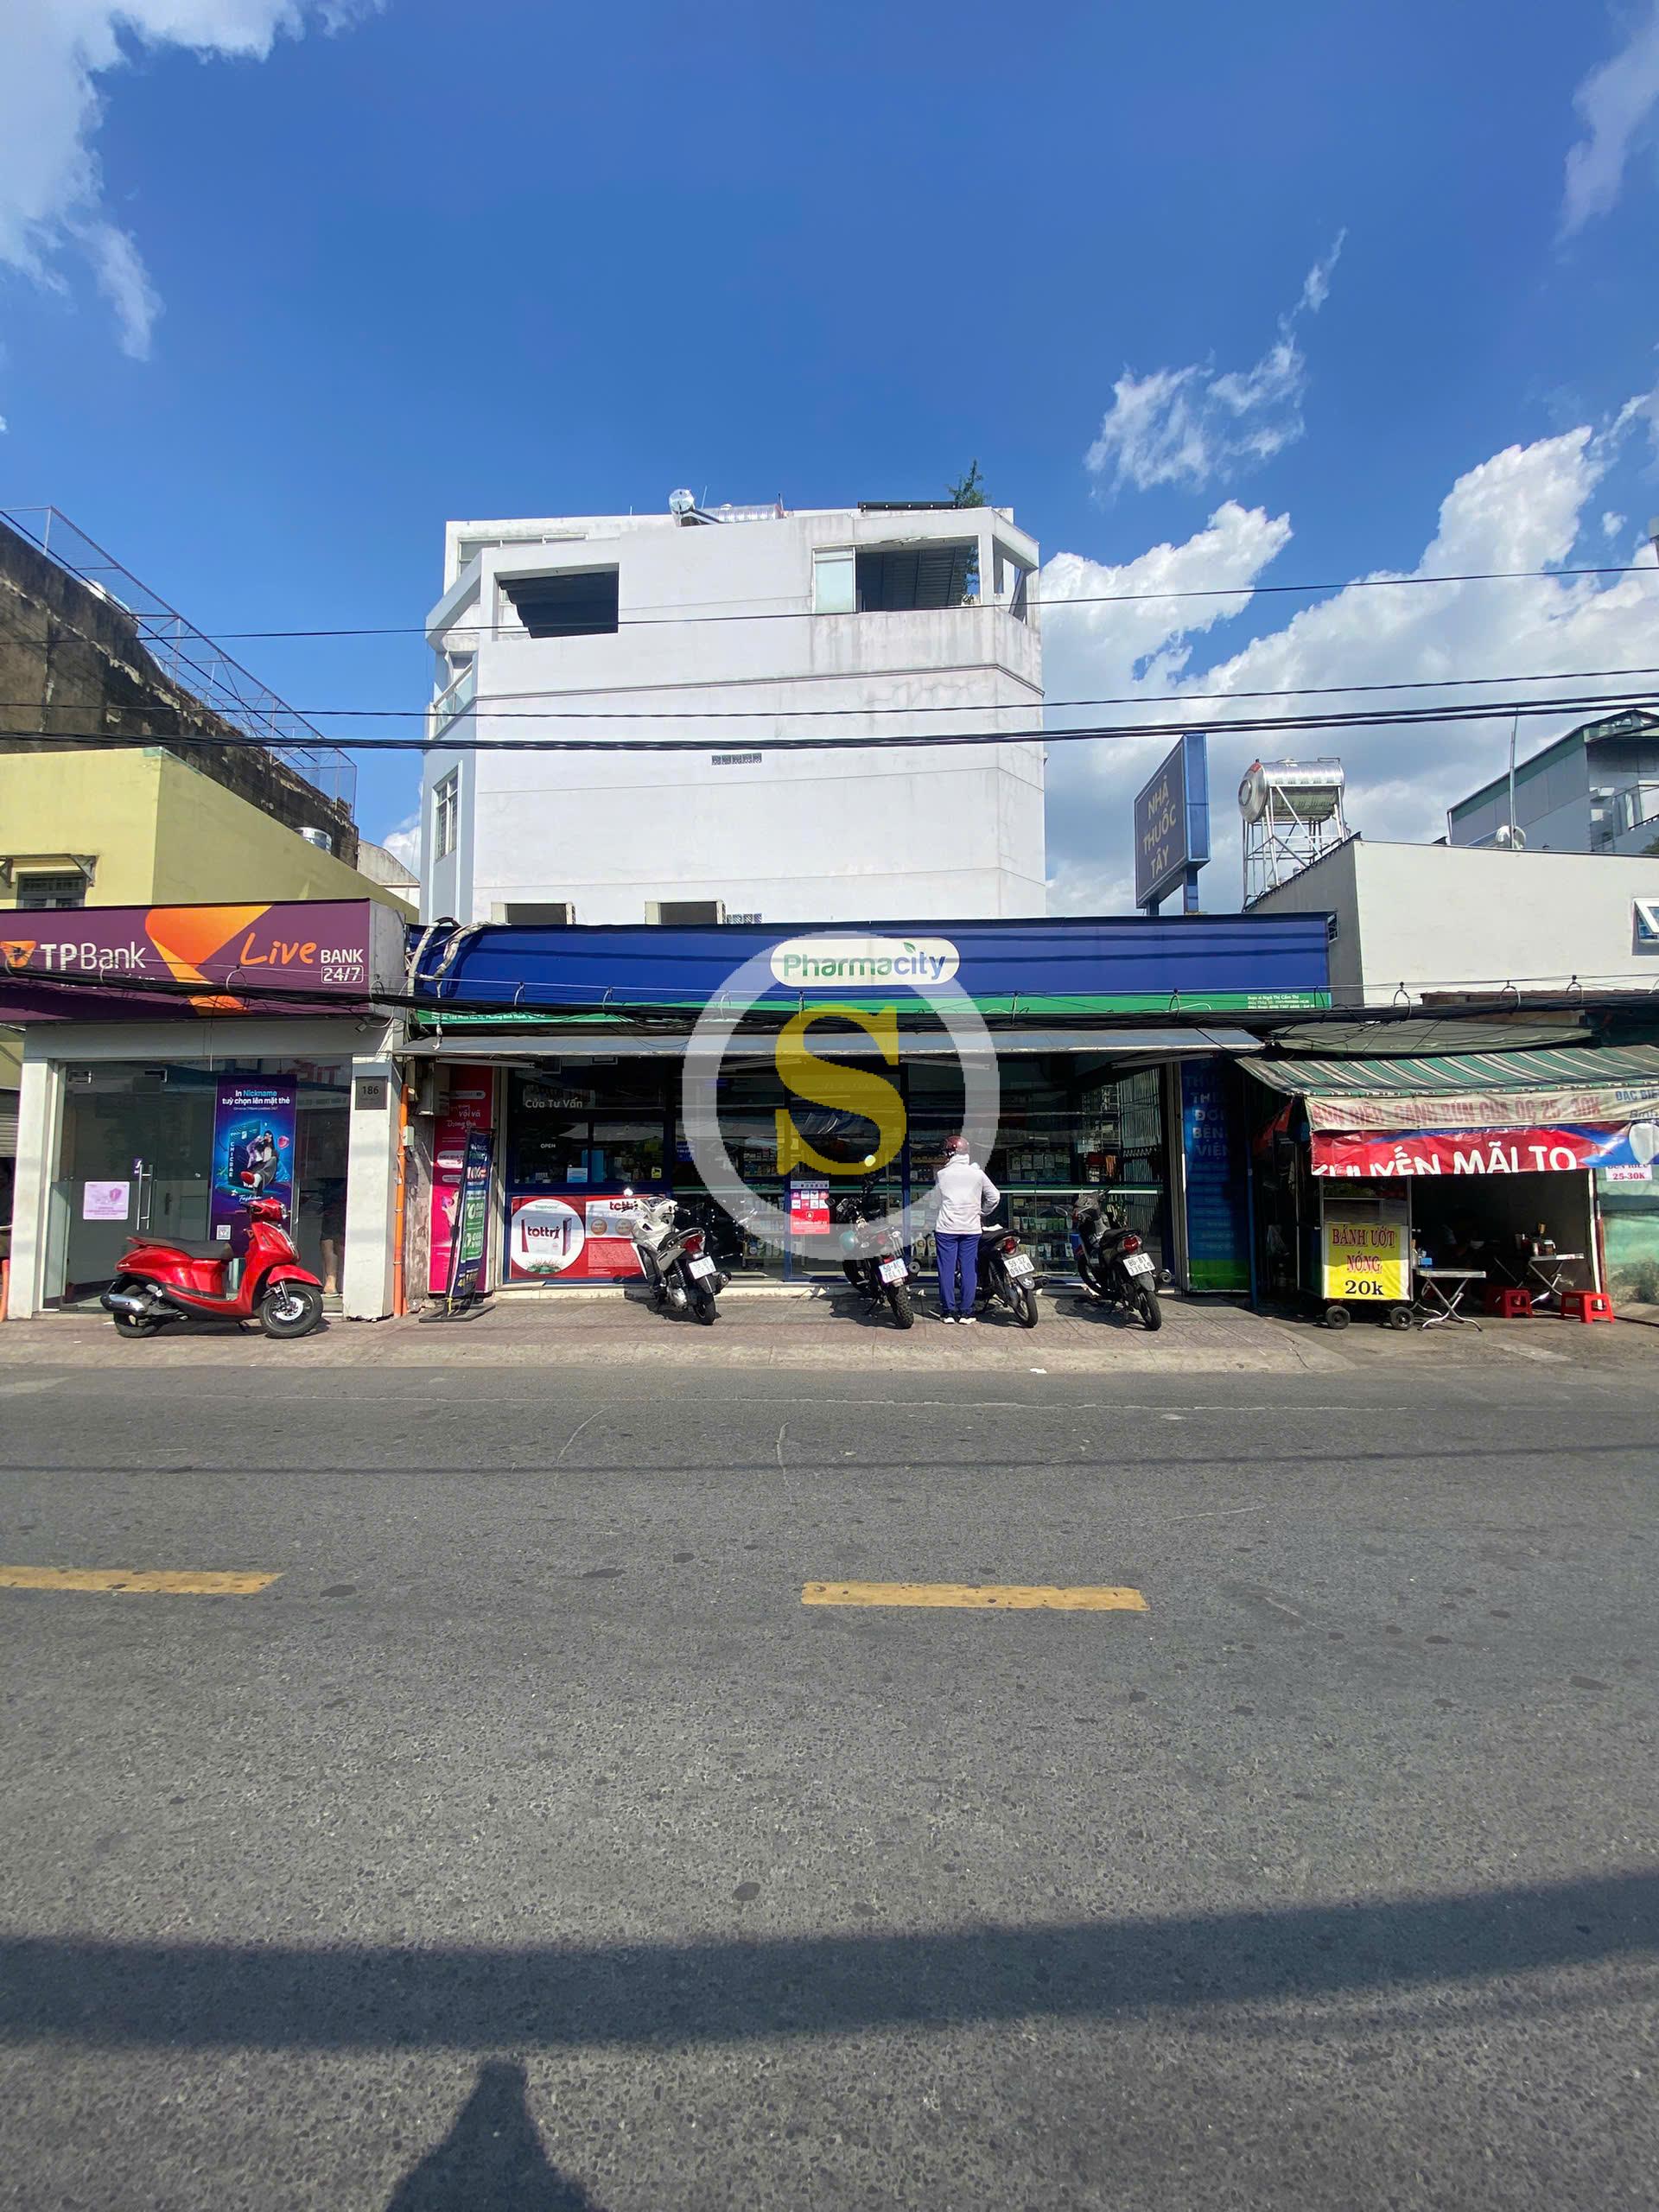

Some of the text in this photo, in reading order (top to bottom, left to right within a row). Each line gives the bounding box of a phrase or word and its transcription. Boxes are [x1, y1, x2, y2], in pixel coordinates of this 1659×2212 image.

[1143, 800, 1176, 855] THUỐC
[1150, 845, 1169, 879] TÂY
[40, 941, 147, 970] TPBank
[240, 932, 364, 965] Live BANK
[322, 967, 361, 982] 24/7
[783, 951, 946, 980] Pharmacity
[362, 1085, 379, 1095] 186
[1453, 1141, 1519, 1175] MÃI
[1528, 1145, 1577, 1172] TO
[527, 1225, 561, 1239] tottri
[1332, 1224, 1367, 1246] BÁNH
[1346, 1250, 1382, 1274] NÓNG
[1344, 1280, 1383, 1296] 20k
